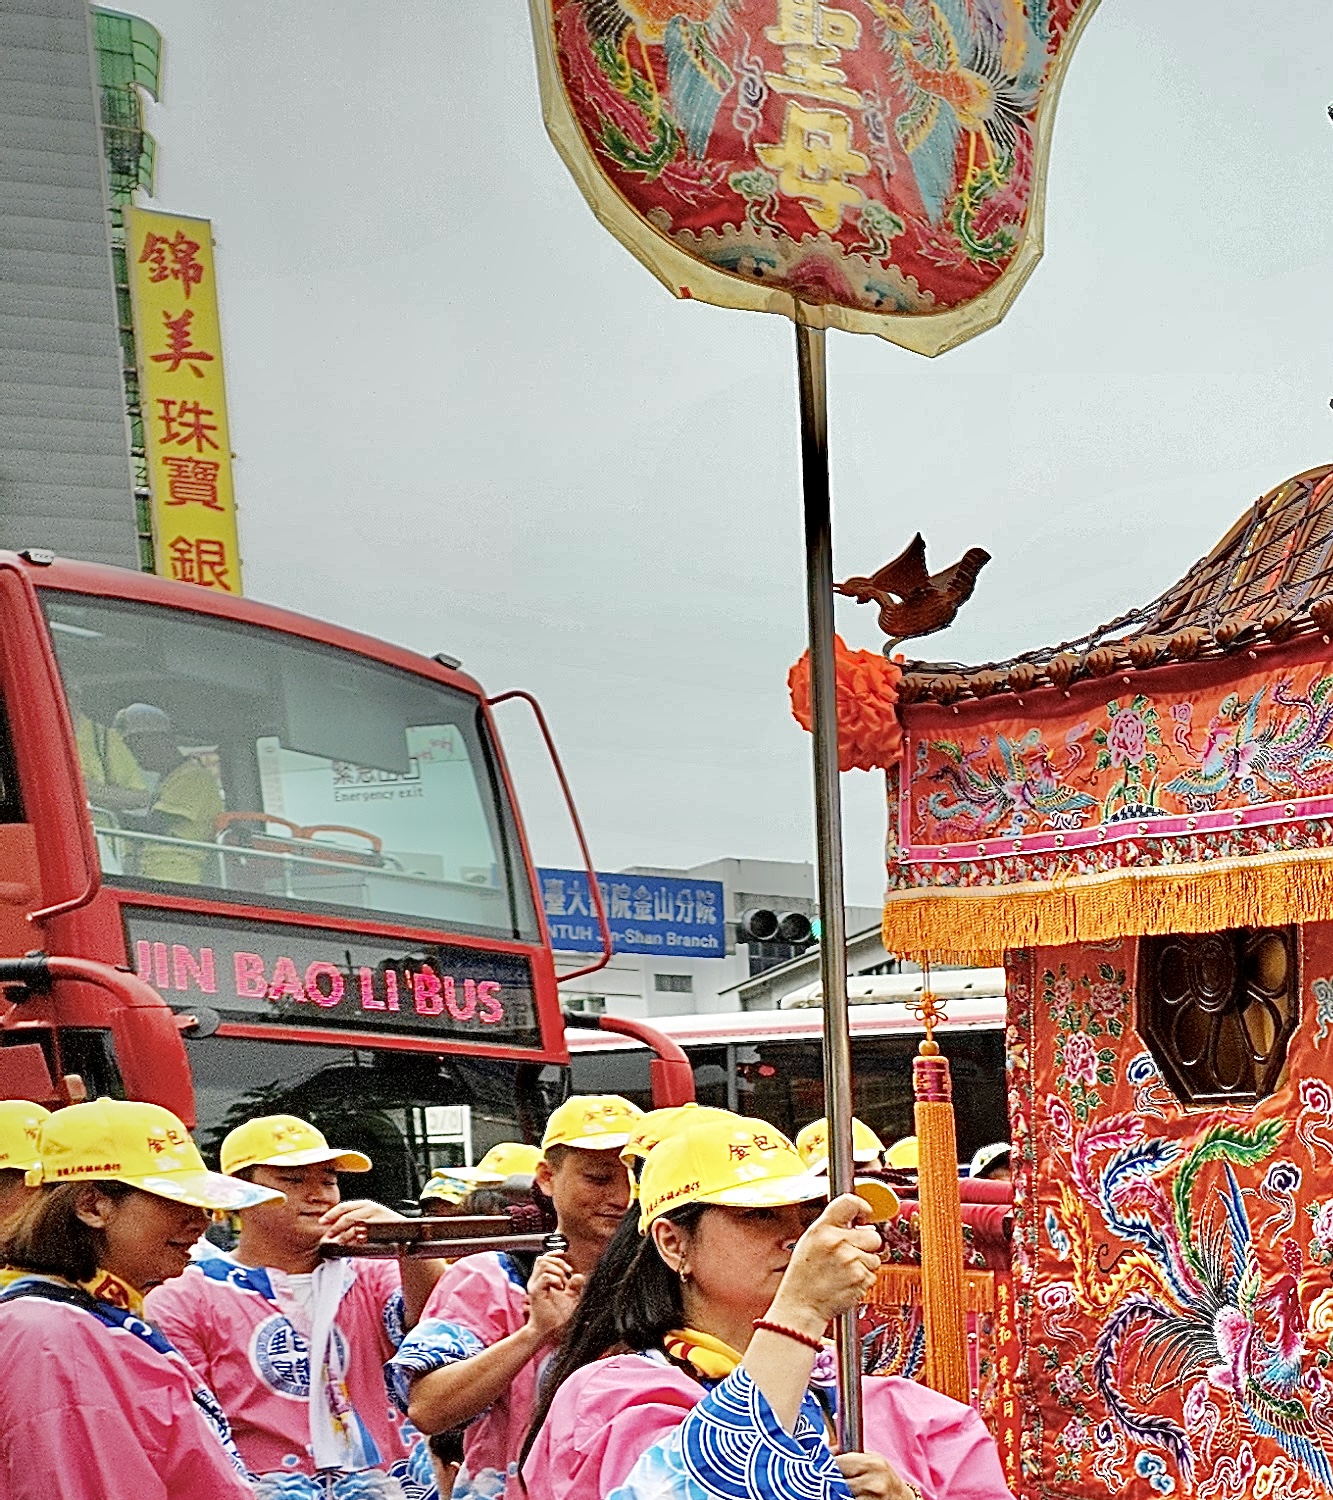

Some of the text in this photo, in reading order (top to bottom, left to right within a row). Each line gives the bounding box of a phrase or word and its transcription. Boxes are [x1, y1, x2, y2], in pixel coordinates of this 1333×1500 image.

[334, 785, 425, 802] Emergency exit
[666, 931, 719, 949] Branch
[234, 951, 346, 1008] BAO
[360, 966, 401, 1011] LI
[412, 971, 504, 1024] BUS
